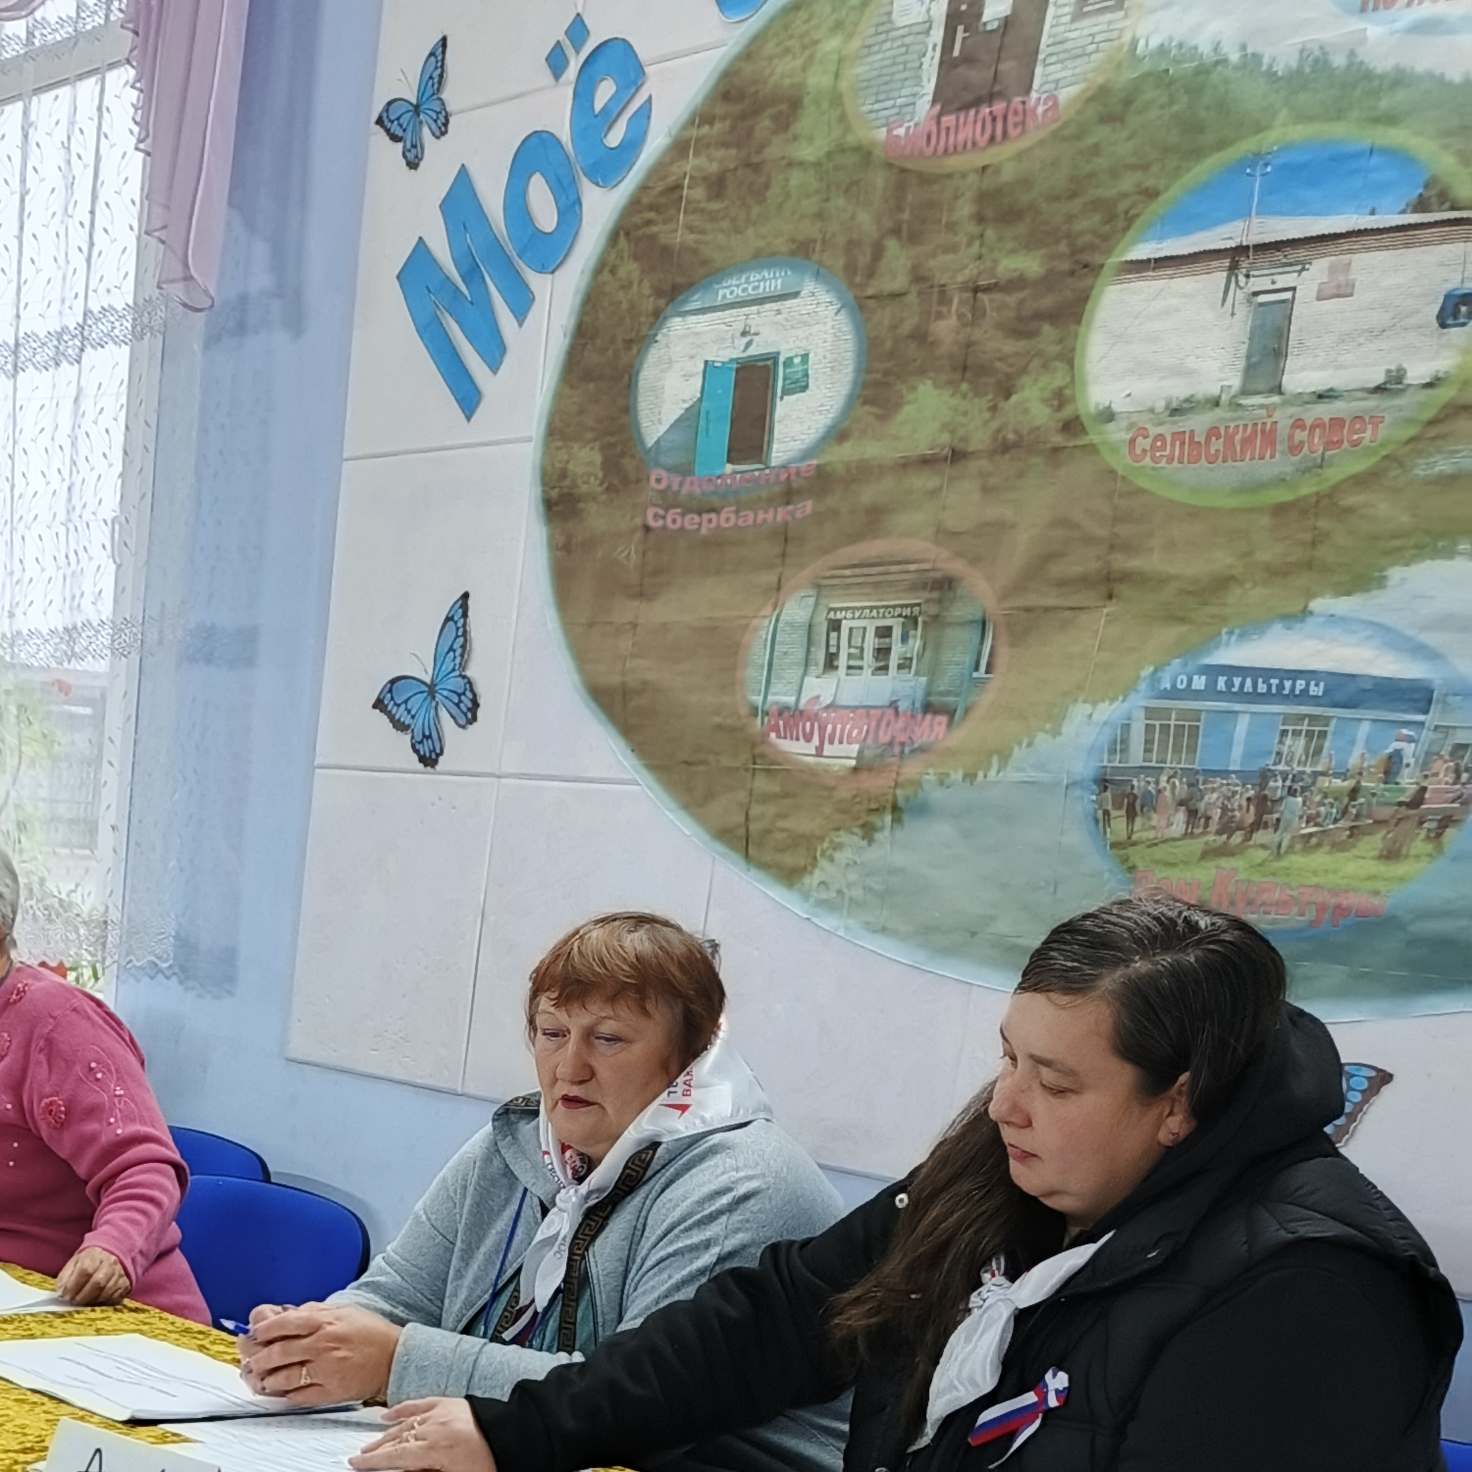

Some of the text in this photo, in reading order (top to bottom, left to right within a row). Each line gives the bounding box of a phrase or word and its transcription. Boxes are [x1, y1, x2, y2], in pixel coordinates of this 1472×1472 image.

[885, 93, 1061, 159] Библиотека
[397, 13, 652, 423] Моё
[717, 277, 782, 303] РОССИИ
[1128, 406, 1385, 465] Сельский совет
[649, 459, 818, 494] Отделение
[646, 500, 813, 534] Сбербанка
[827, 606, 921, 620] АМБУЛАТОРИЯ
[1161, 674, 1325, 697] ДОМ КУЛЬТУРЫ
[765, 695, 949, 757] Амбулатория
[1209, 866, 1389, 929] Культуры
